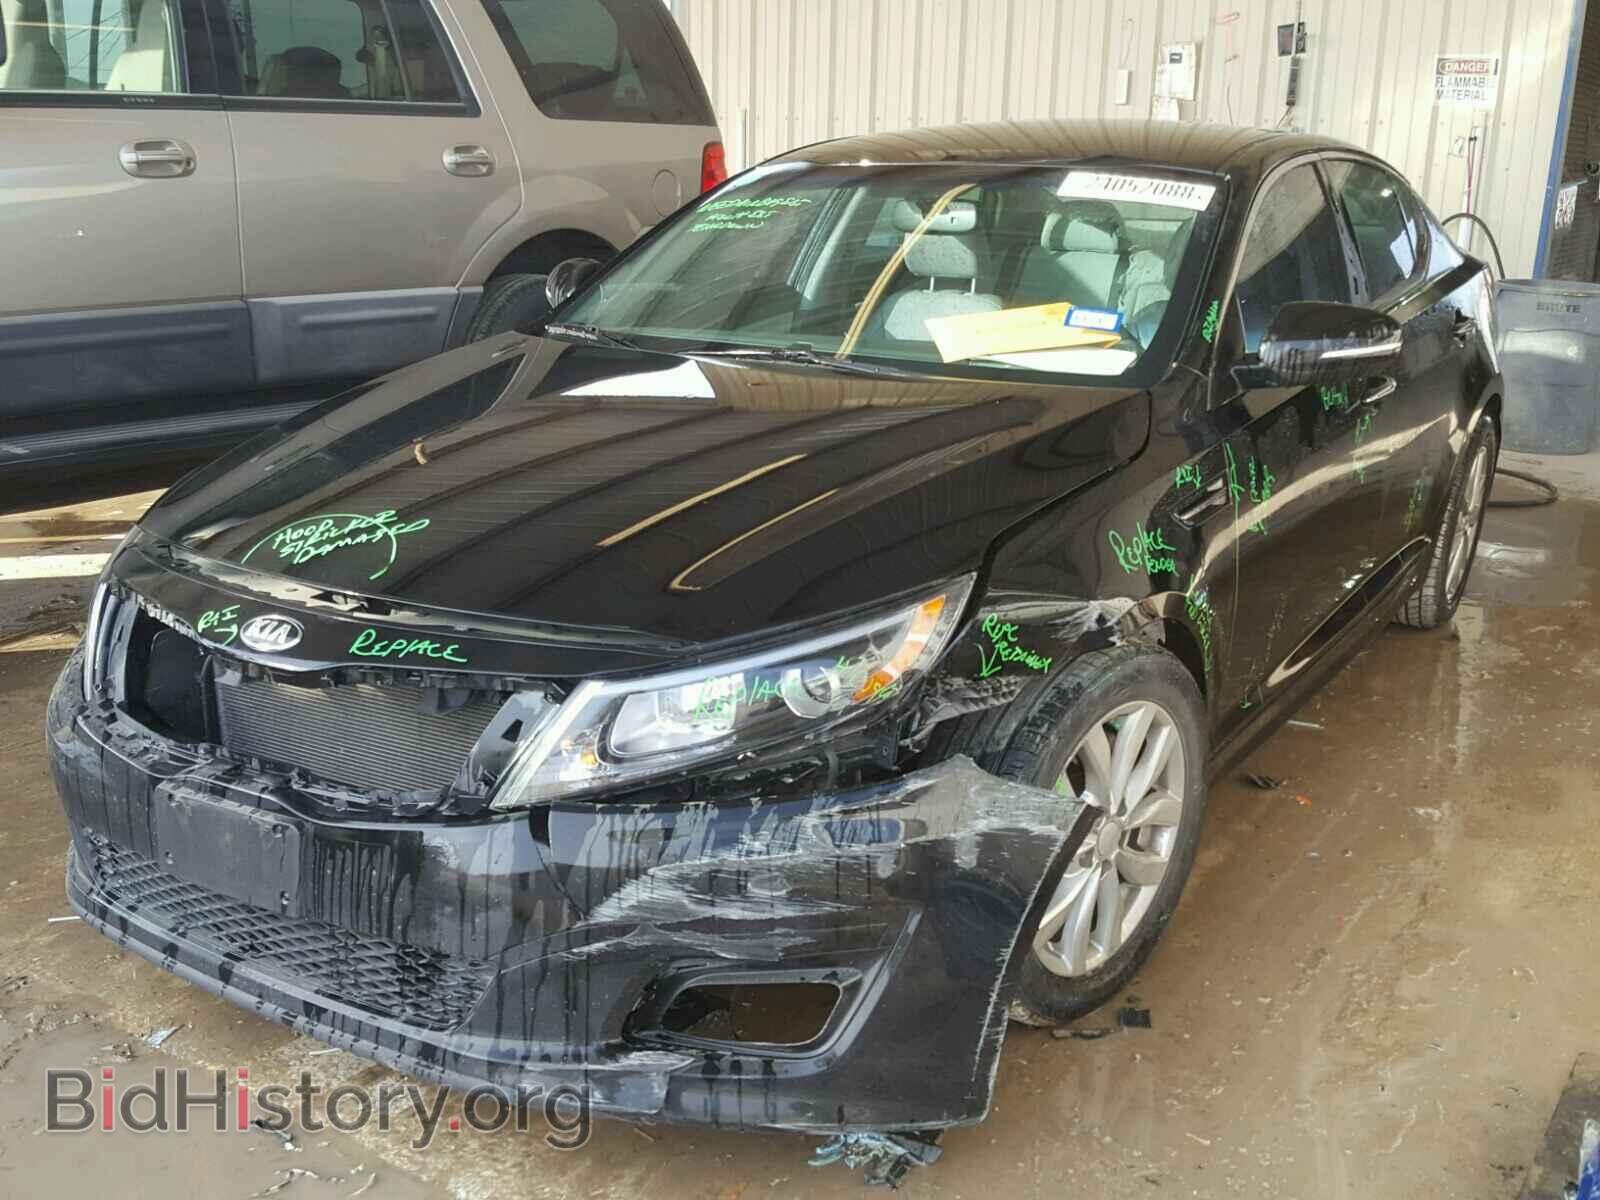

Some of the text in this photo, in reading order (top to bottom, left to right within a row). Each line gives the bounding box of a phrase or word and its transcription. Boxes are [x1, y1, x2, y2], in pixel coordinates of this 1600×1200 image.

[1445, 62, 1488, 72] DANGER
[1435, 76, 1490, 89] FLAMMAB
[244, 619, 293, 645] KIA
